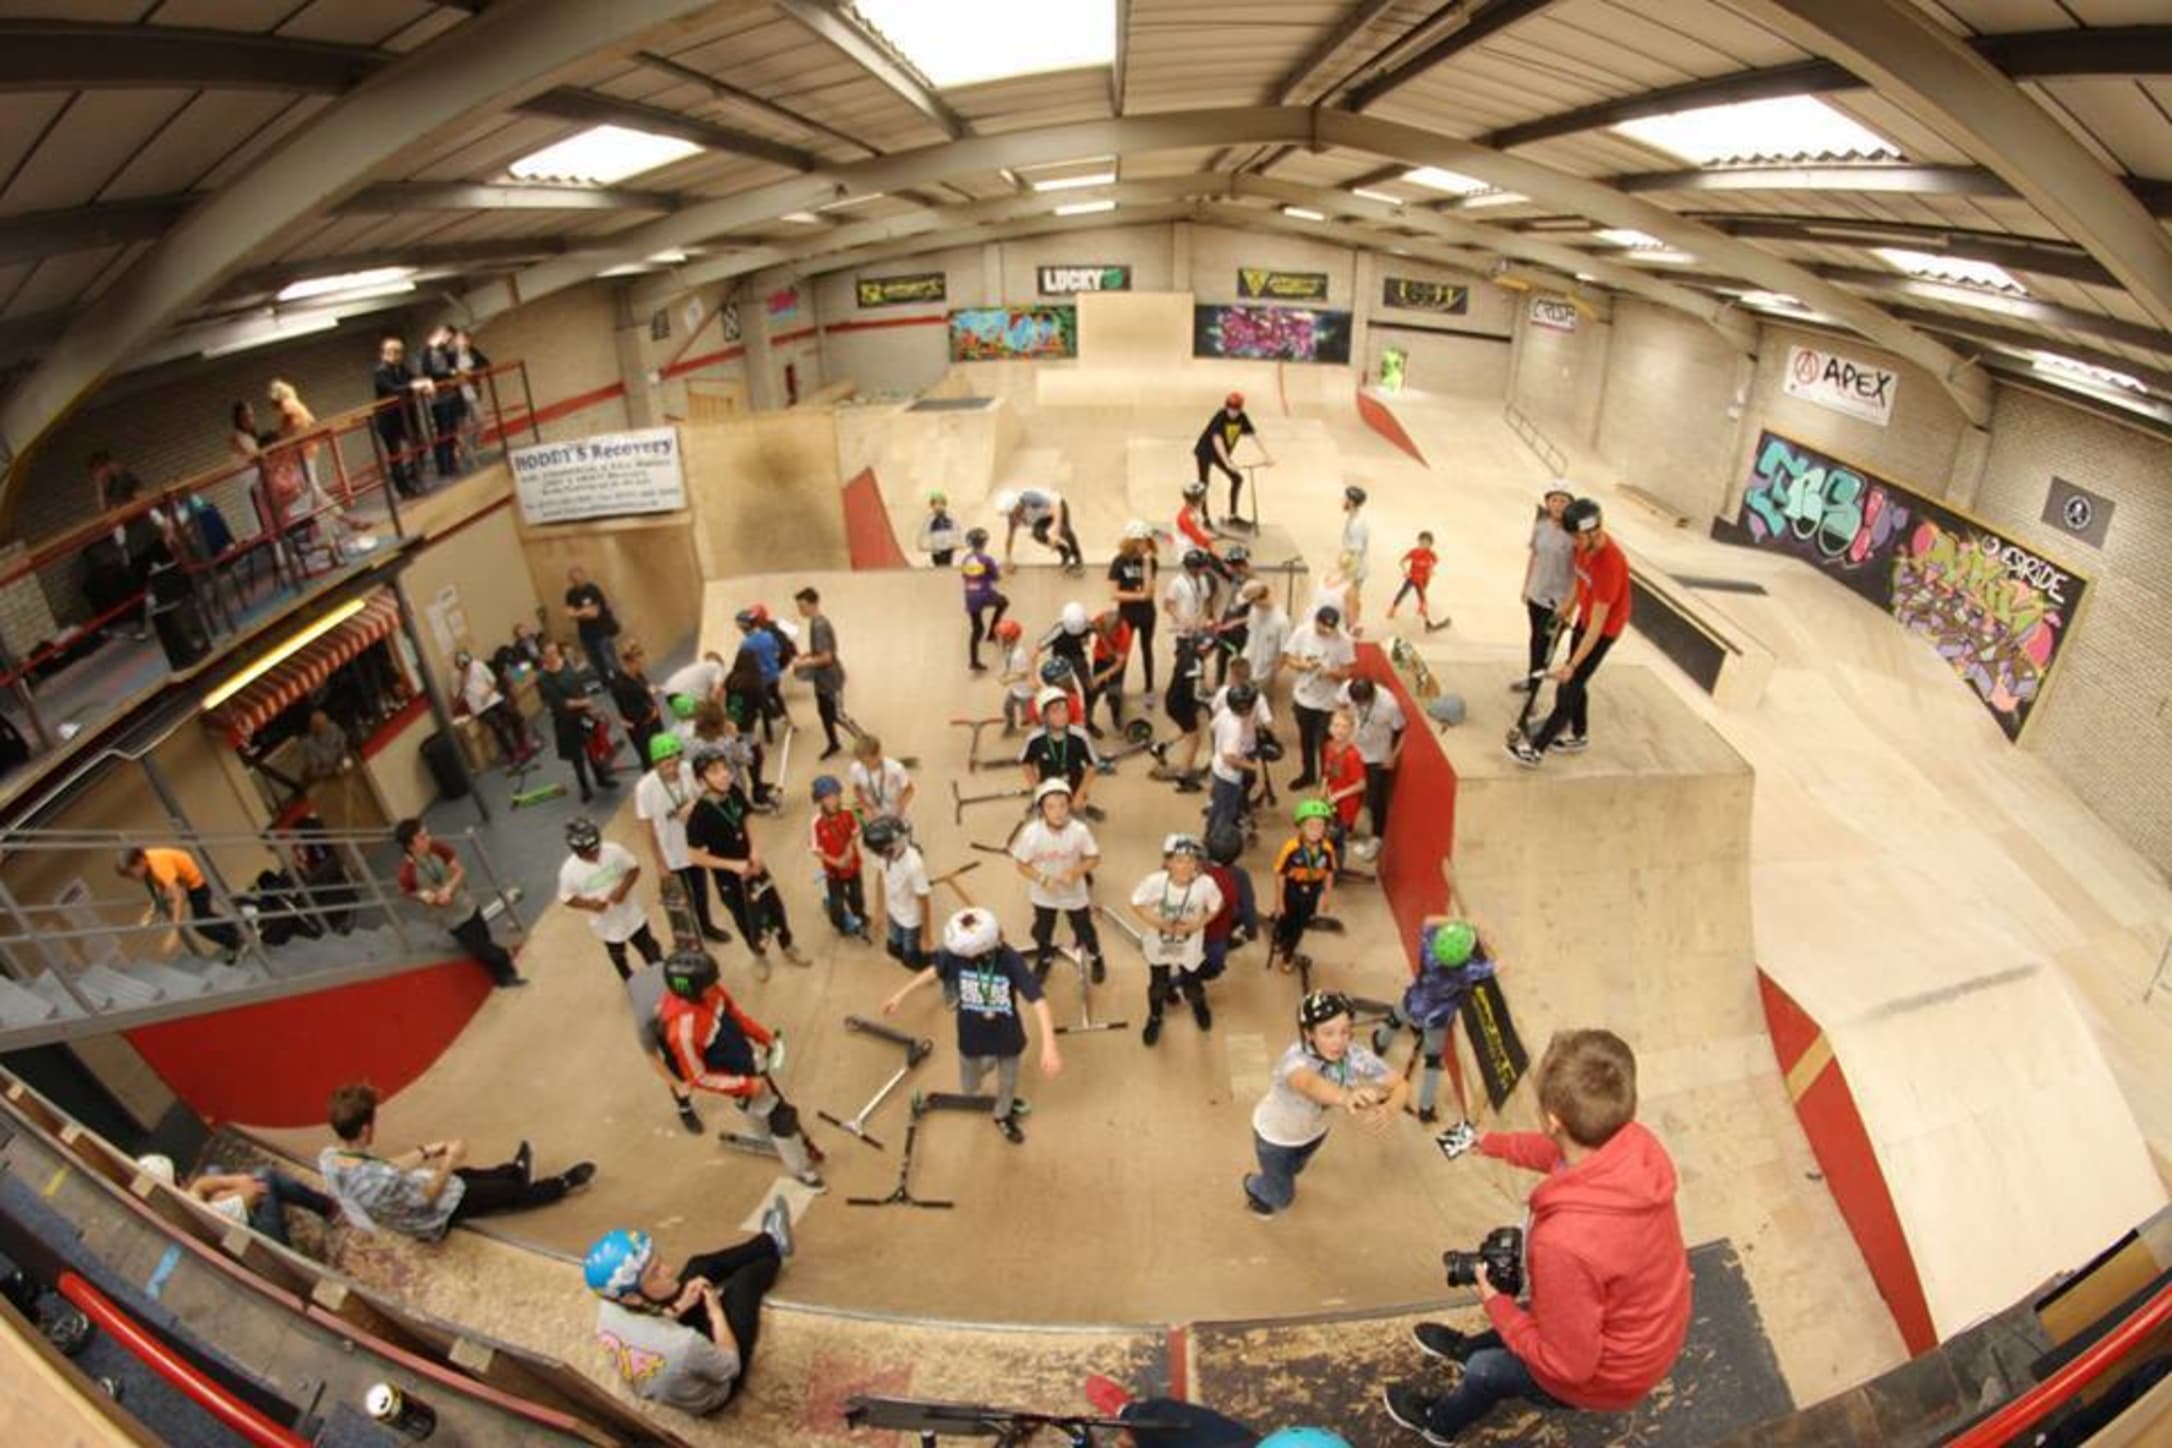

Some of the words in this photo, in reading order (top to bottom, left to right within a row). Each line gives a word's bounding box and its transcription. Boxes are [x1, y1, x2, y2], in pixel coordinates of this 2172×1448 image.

[1044, 268, 1104, 292] LUCKY
[1823, 358, 1891, 408] APEX
[591, 439, 672, 458] Recovery
